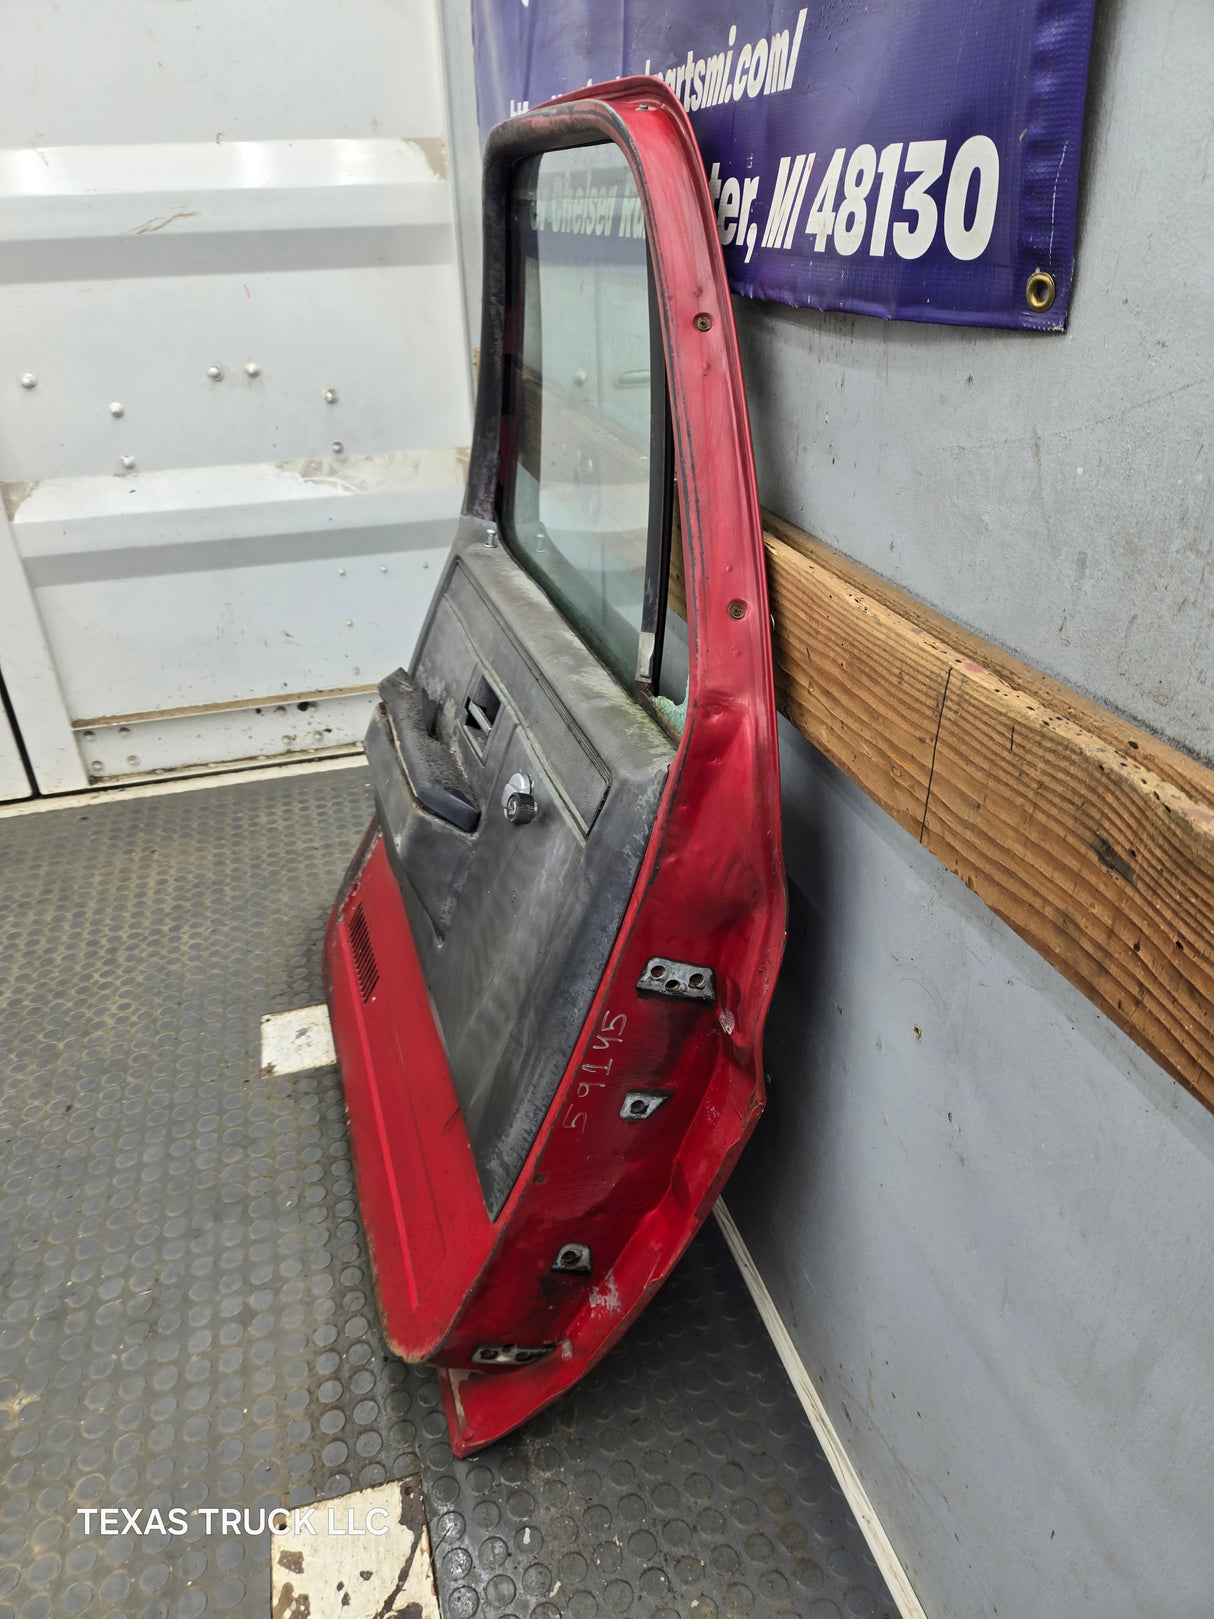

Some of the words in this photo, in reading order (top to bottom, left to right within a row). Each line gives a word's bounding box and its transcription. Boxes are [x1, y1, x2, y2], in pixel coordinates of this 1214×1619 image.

[645, 8, 808, 113] artsmi.com/
[761, 152, 817, 250] MI
[805, 134, 1000, 261] 48130
